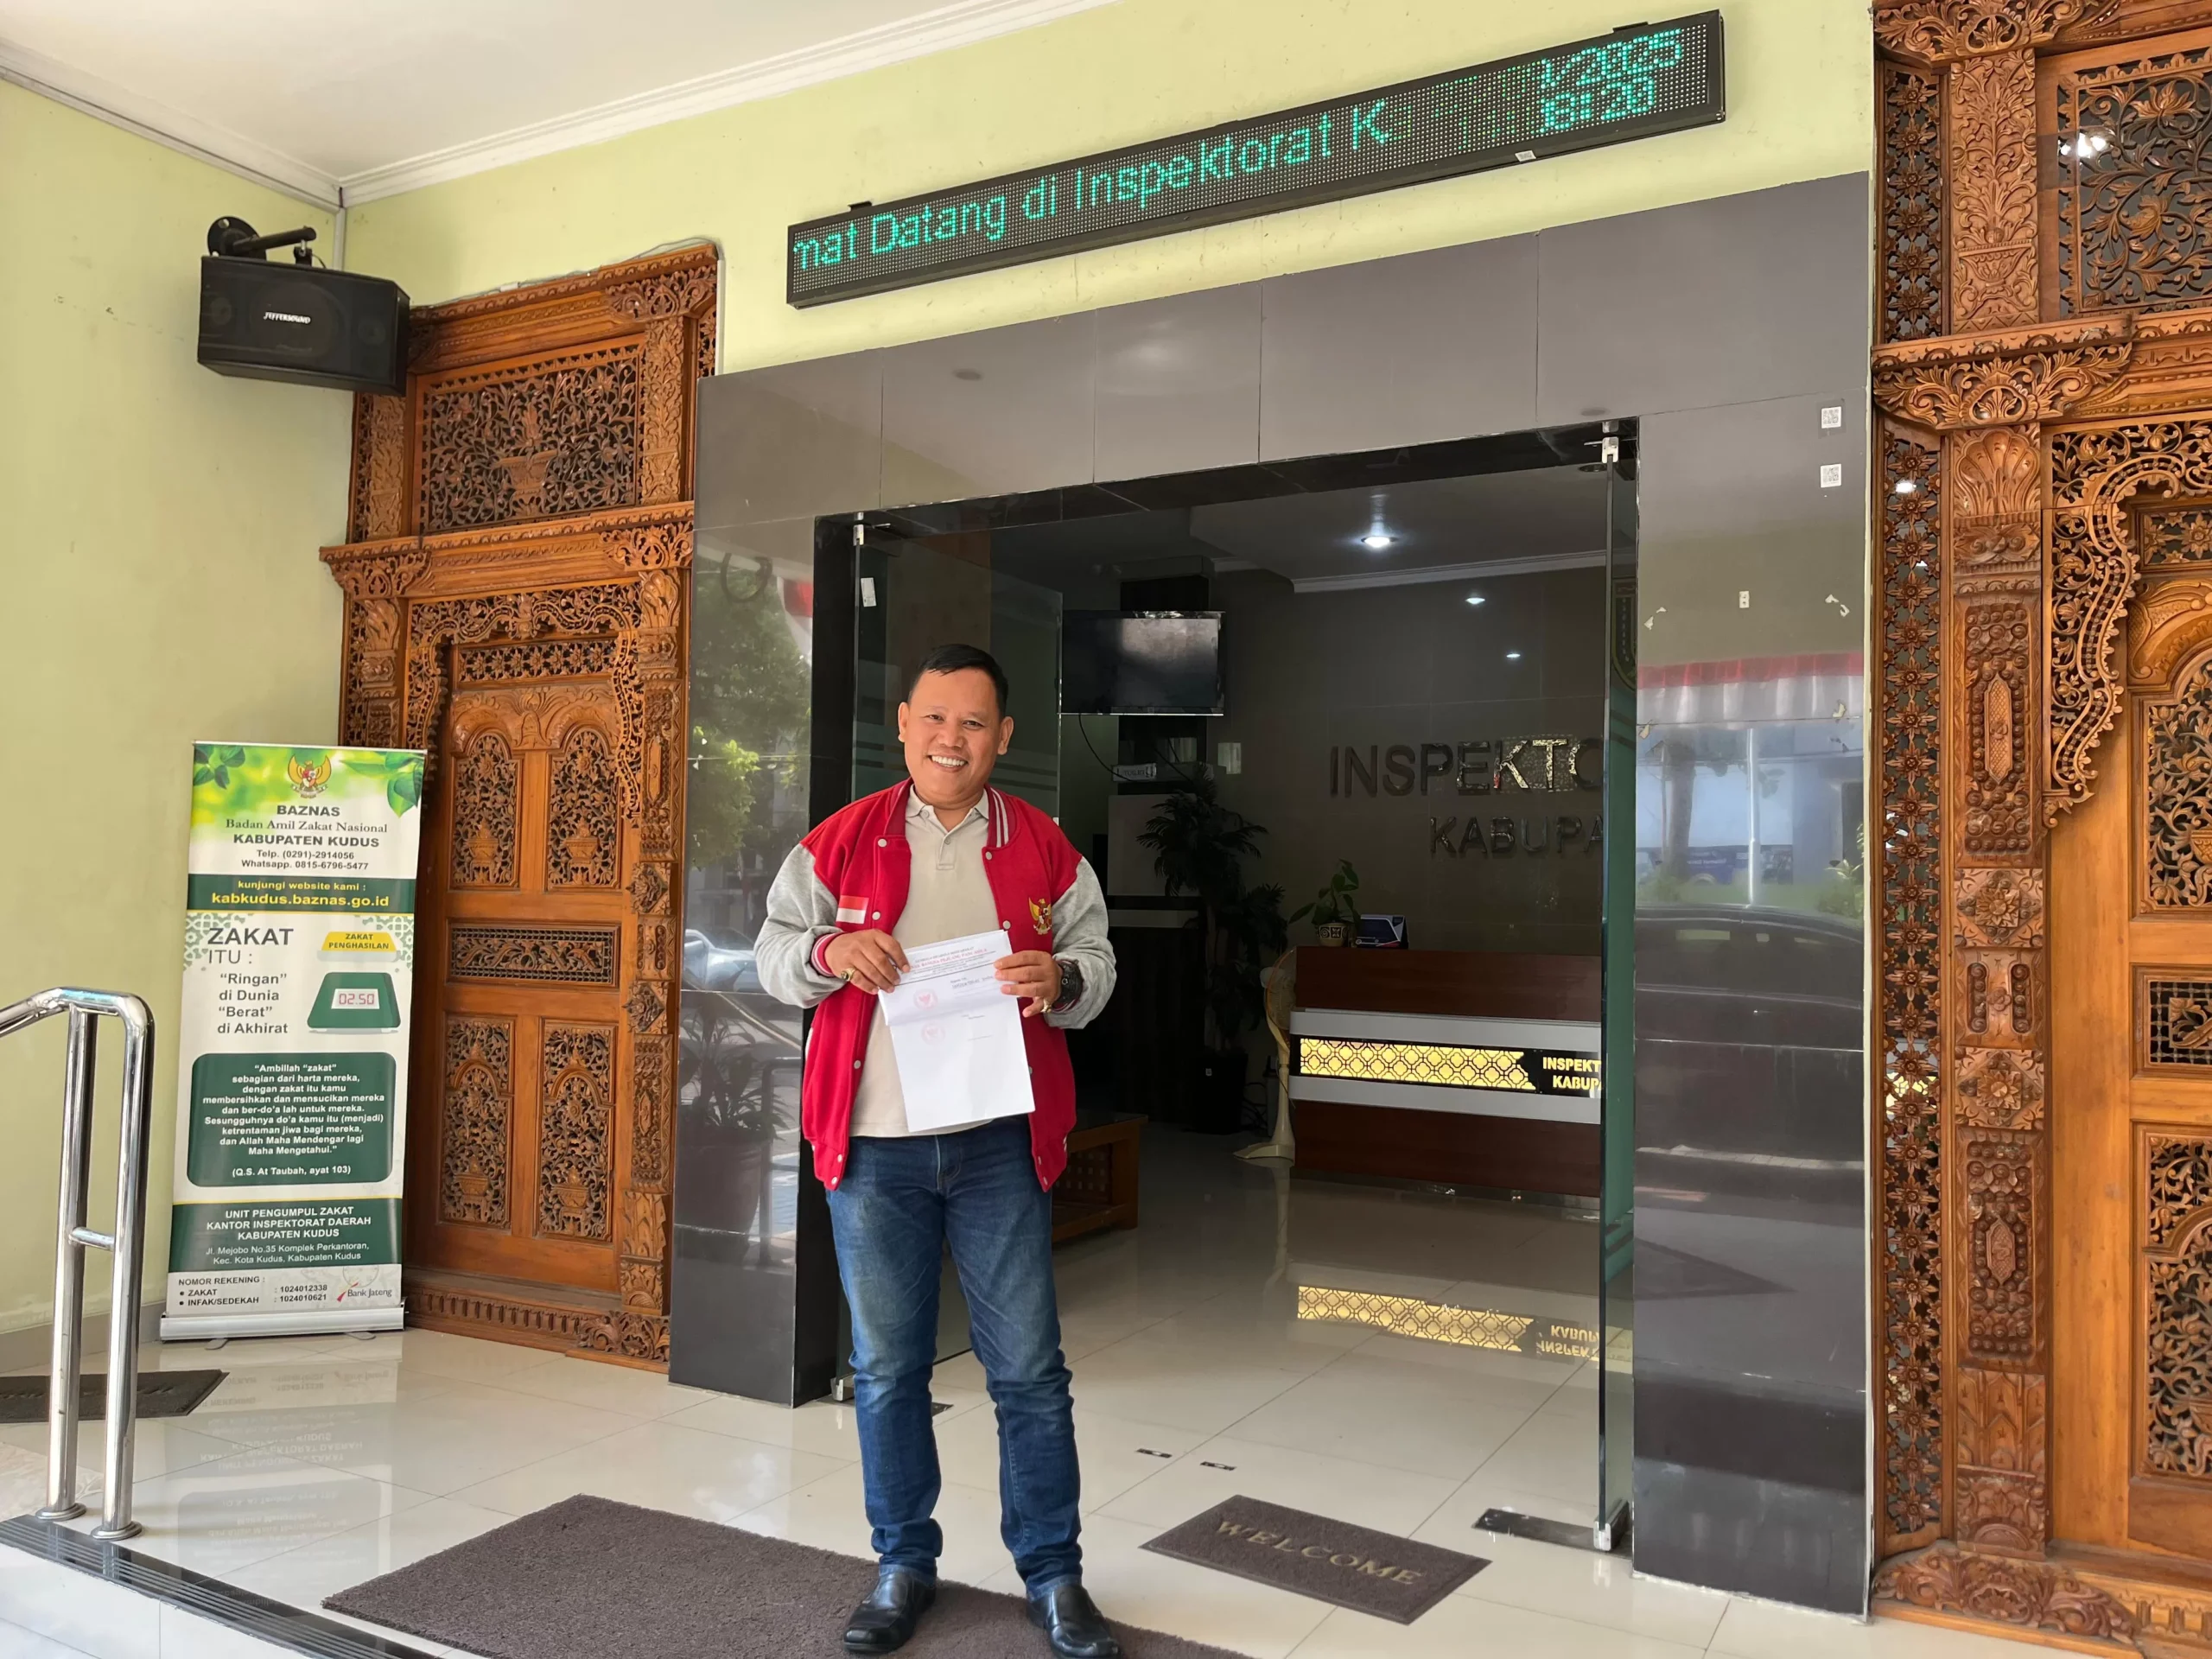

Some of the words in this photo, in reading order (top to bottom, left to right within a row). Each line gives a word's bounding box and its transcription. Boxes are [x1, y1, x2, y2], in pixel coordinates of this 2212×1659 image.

[871, 194, 1006, 254] Datang
[1021, 175, 1056, 219] di
[1077, 112, 1333, 210] Inspektorat
[276, 804, 340, 817] BAZNAS
[226, 819, 264, 830] Badan
[267, 820, 295, 830] Amil
[298, 822, 332, 831] Zakat
[335, 823, 388, 833] Nasional
[233, 834, 322, 845] KABUPATEN
[327, 836, 379, 848] KUDUS
[257, 849, 279, 860] Telp.
[283, 850, 354, 860] (0291)-2914056
[242, 860, 293, 869] Whatsapp.
[296, 861, 369, 870] 0815-6796-5477
[238, 880, 285, 891] kunjungi
[289, 881, 331, 891] website
[334, 882, 359, 891] kami
[212, 893, 390, 908] kabkudus.baznas.go.id
[207, 928, 294, 945] ZAKAT
[208, 950, 241, 964] ITU
[219, 990, 232, 1001] di
[237, 990, 279, 1001] Dunia
[339, 993, 375, 1005] 02.50
[217, 1023, 231, 1034] di
[234, 1023, 289, 1034] Akhirat
[232, 1075, 275, 1084] sebagian
[324, 1074, 360, 1083] mereka,
[242, 1085, 277, 1095] dengan
[273, 1095, 291, 1103] dan
[293, 1094, 348, 1103] mensucikan
[205, 1116, 274, 1126] Sesungguhnya
[340, 1114, 384, 1123] (menjadi)
[222, 1127, 280, 1135] ketrentaman
[282, 1126, 301, 1135] jiwa
[303, 1125, 324, 1135] bagi
[293, 1135, 345, 1144] Mendengar
[346, 1135, 364, 1144] lagi
[248, 1147, 273, 1155] Maha
[232, 1168, 256, 1178] (Q.S.
[270, 1166, 307, 1175] Taubah,
[309, 1167, 329, 1176] ayat
[332, 1166, 352, 1174] 103)
[226, 1210, 250, 1219] UNIT
[252, 1208, 317, 1217] PENGUMPUL
[320, 1206, 354, 1216] ZAKAT
[207, 1221, 251, 1230] KANTOR
[253, 1218, 326, 1229] INSPEKTORAT
[327, 1217, 372, 1226] DAERAH
[238, 1230, 301, 1241] KABUPATEN
[303, 1229, 340, 1238] KUDUS
[218, 1246, 249, 1256] Mejobo
[251, 1245, 276, 1254] No.35
[278, 1243, 315, 1253] Komplek
[317, 1243, 369, 1251] Perkantoran,
[257, 1255, 285, 1263] Kudus,
[288, 1253, 333, 1262] Kabupaten
[215, 1276, 260, 1285] REKENING
[188, 1288, 218, 1297] ZAKAT
[347, 1288, 367, 1297] Bank
[368, 1288, 392, 1298] Jateng
[188, 1297, 259, 1306] INFAK/SEDEKAH
[1217, 1521, 1423, 1585] WELCOME
